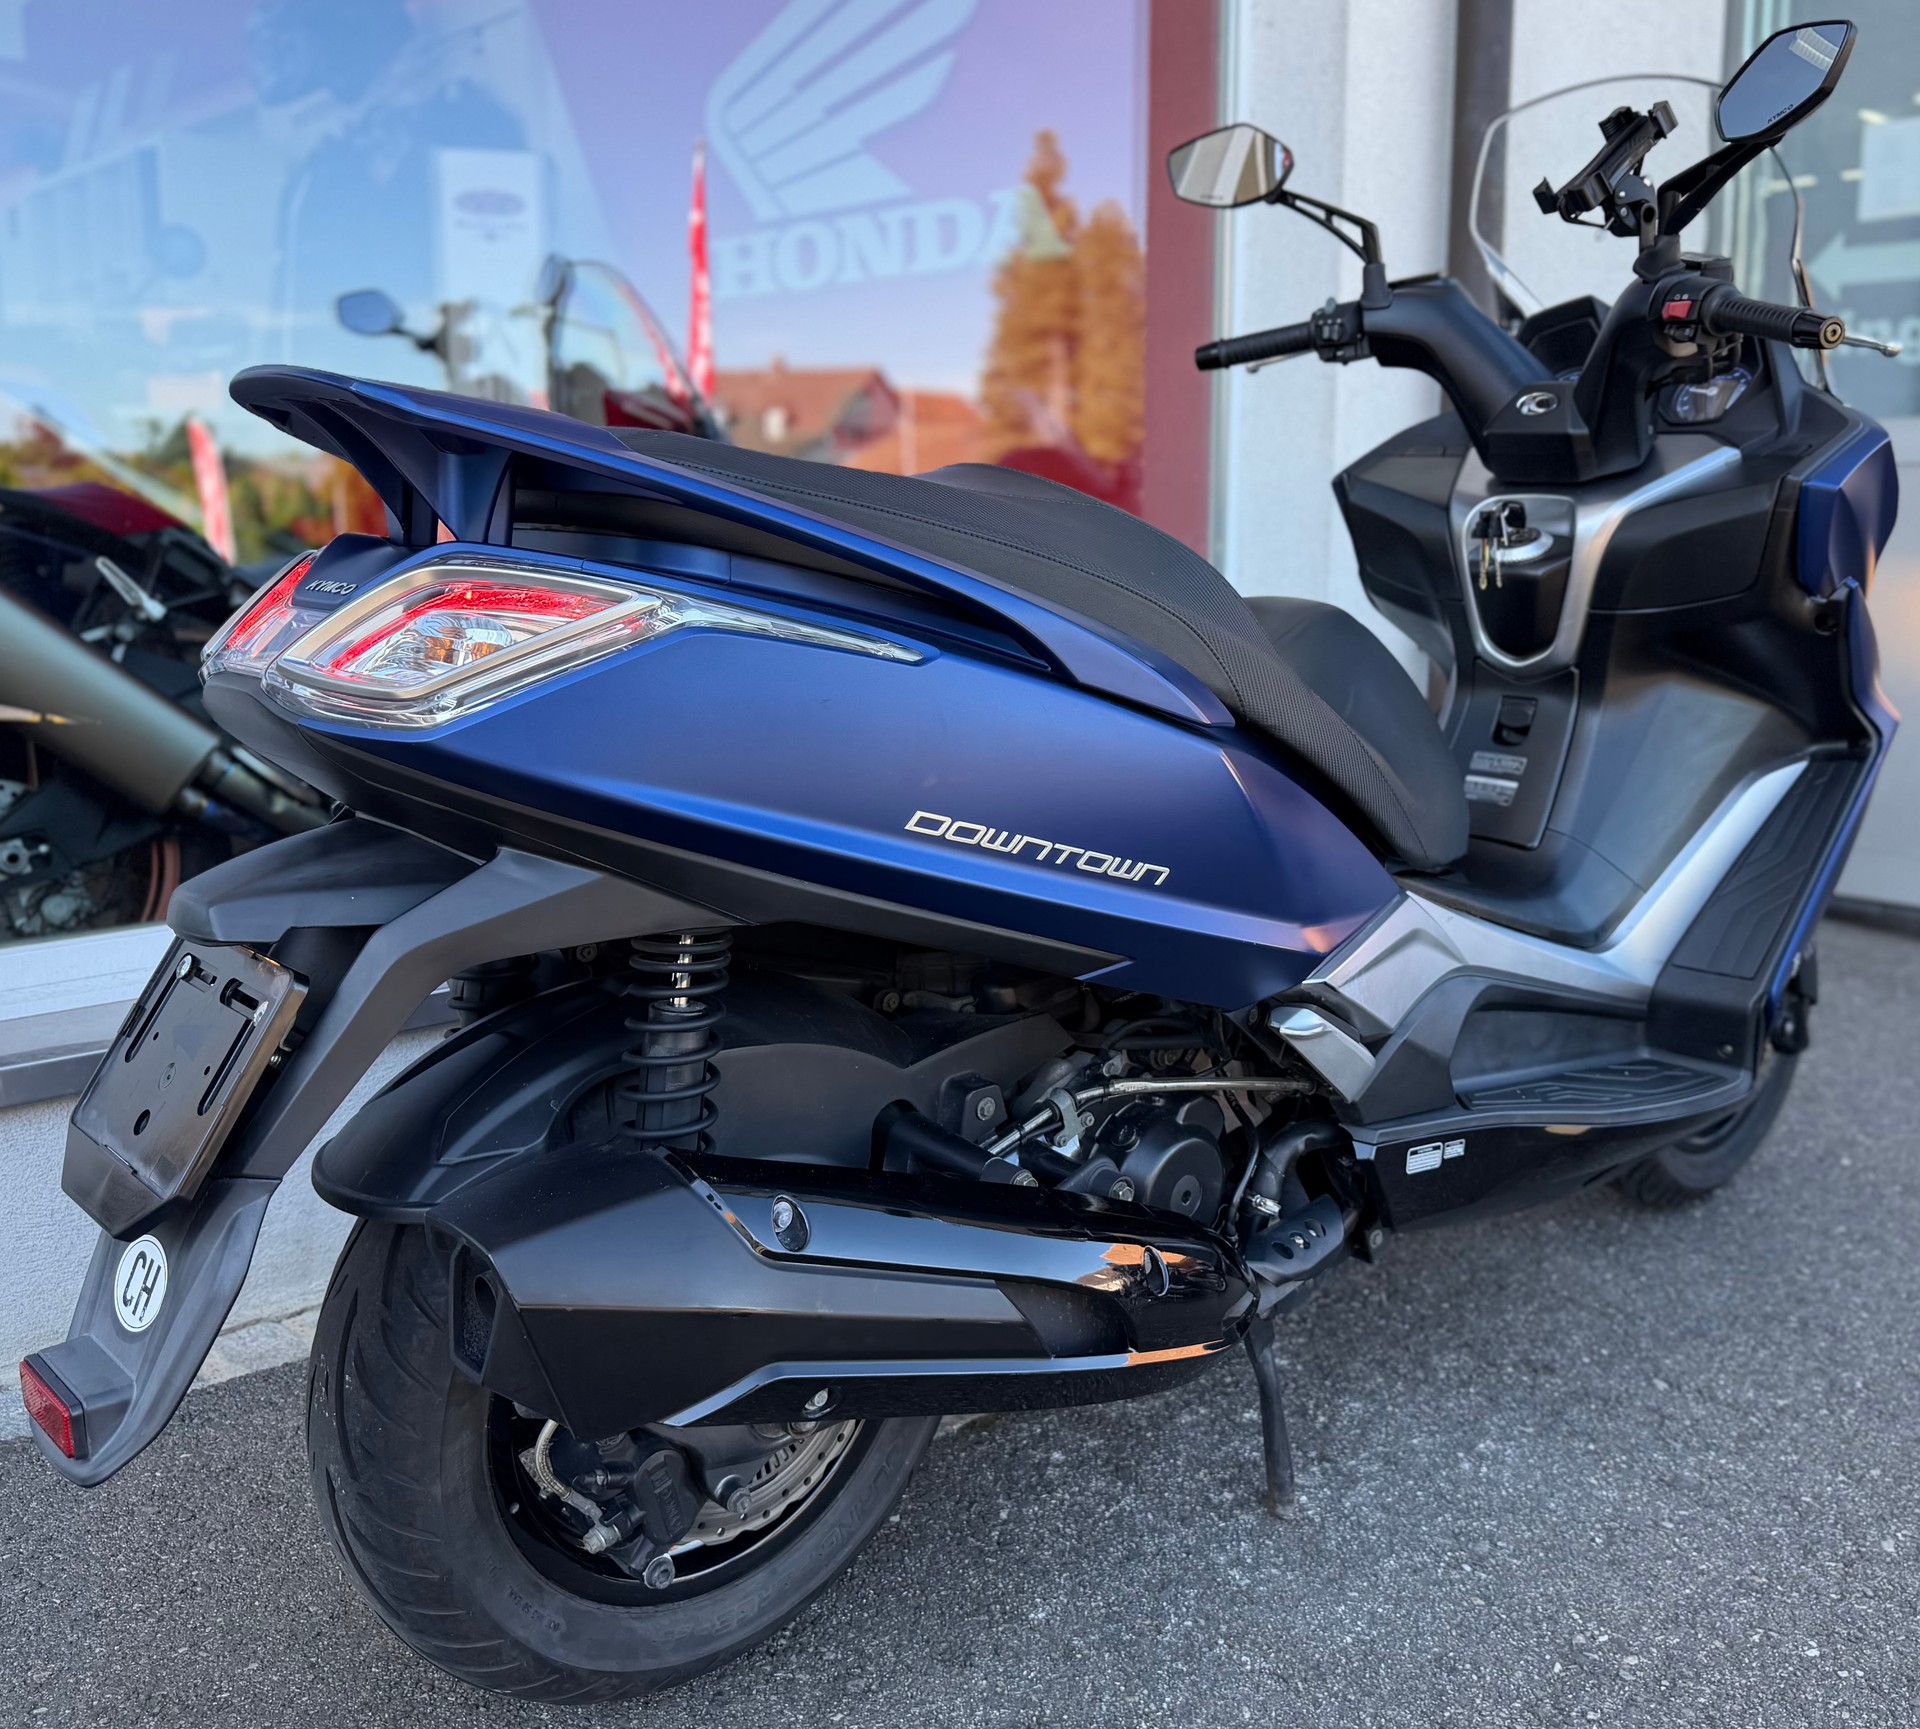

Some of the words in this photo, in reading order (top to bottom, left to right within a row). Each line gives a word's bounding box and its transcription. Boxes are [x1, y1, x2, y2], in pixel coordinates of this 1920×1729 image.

[1768, 104, 1794, 124] KYMCO
[711, 182, 1072, 300] HONDA
[305, 580, 357, 595] KYMCO
[123, 1251, 161, 1323] CH
